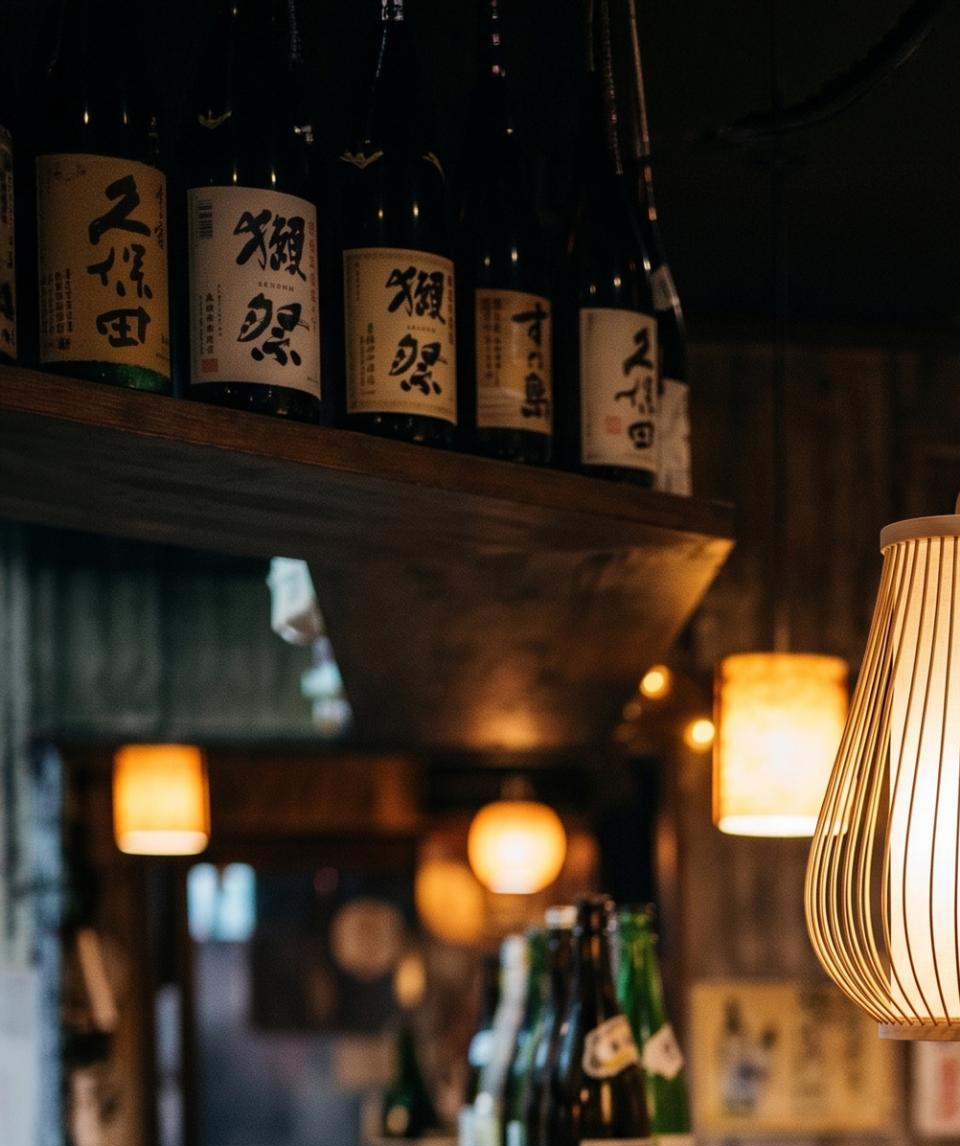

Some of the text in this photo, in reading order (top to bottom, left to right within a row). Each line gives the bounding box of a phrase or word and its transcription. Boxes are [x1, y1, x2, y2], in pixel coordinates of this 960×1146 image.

[87, 174, 151, 347] 久保田
[233, 209, 309, 366] 獺祭
[386, 266, 447, 395] 獺祭
[615, 327, 655, 449] 久保田
